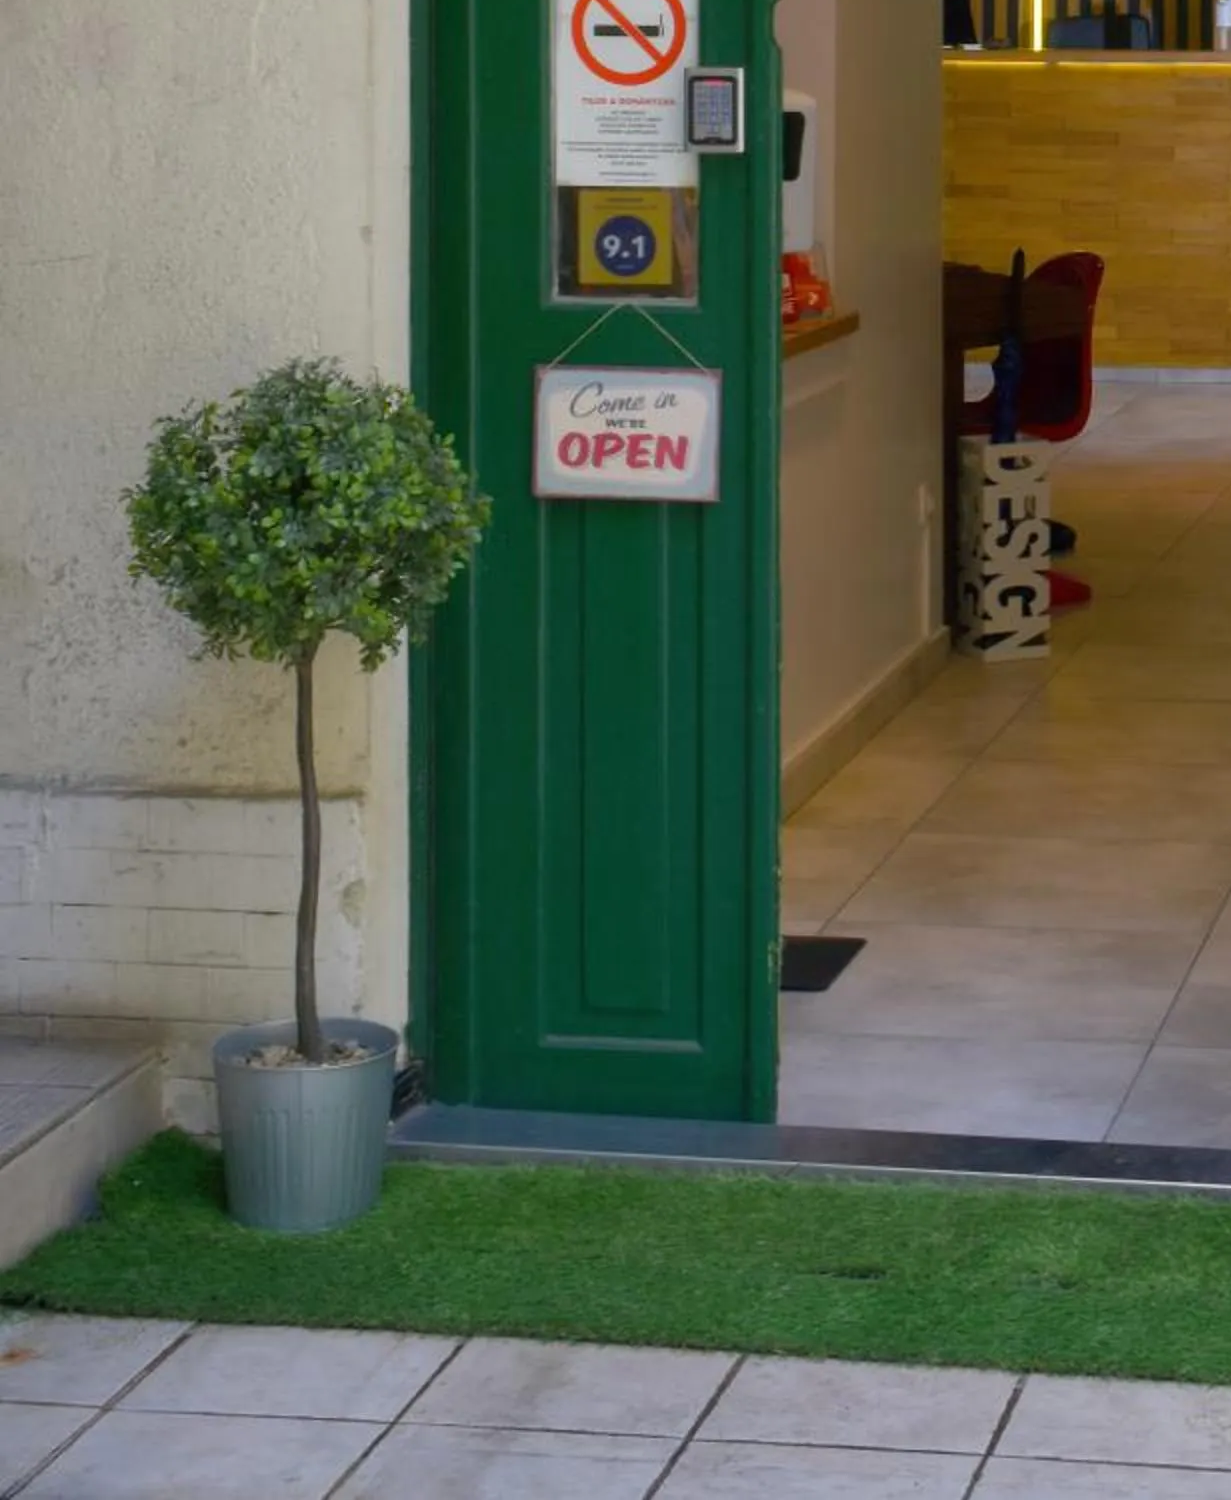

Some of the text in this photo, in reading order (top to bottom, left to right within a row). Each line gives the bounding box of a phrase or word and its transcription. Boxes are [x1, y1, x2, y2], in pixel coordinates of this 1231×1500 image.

[603, 235, 645, 258] 9.1
[569, 381, 679, 418] Come in
[557, 432, 688, 470] OPEN
[981, 441, 1051, 663] DESIGN
